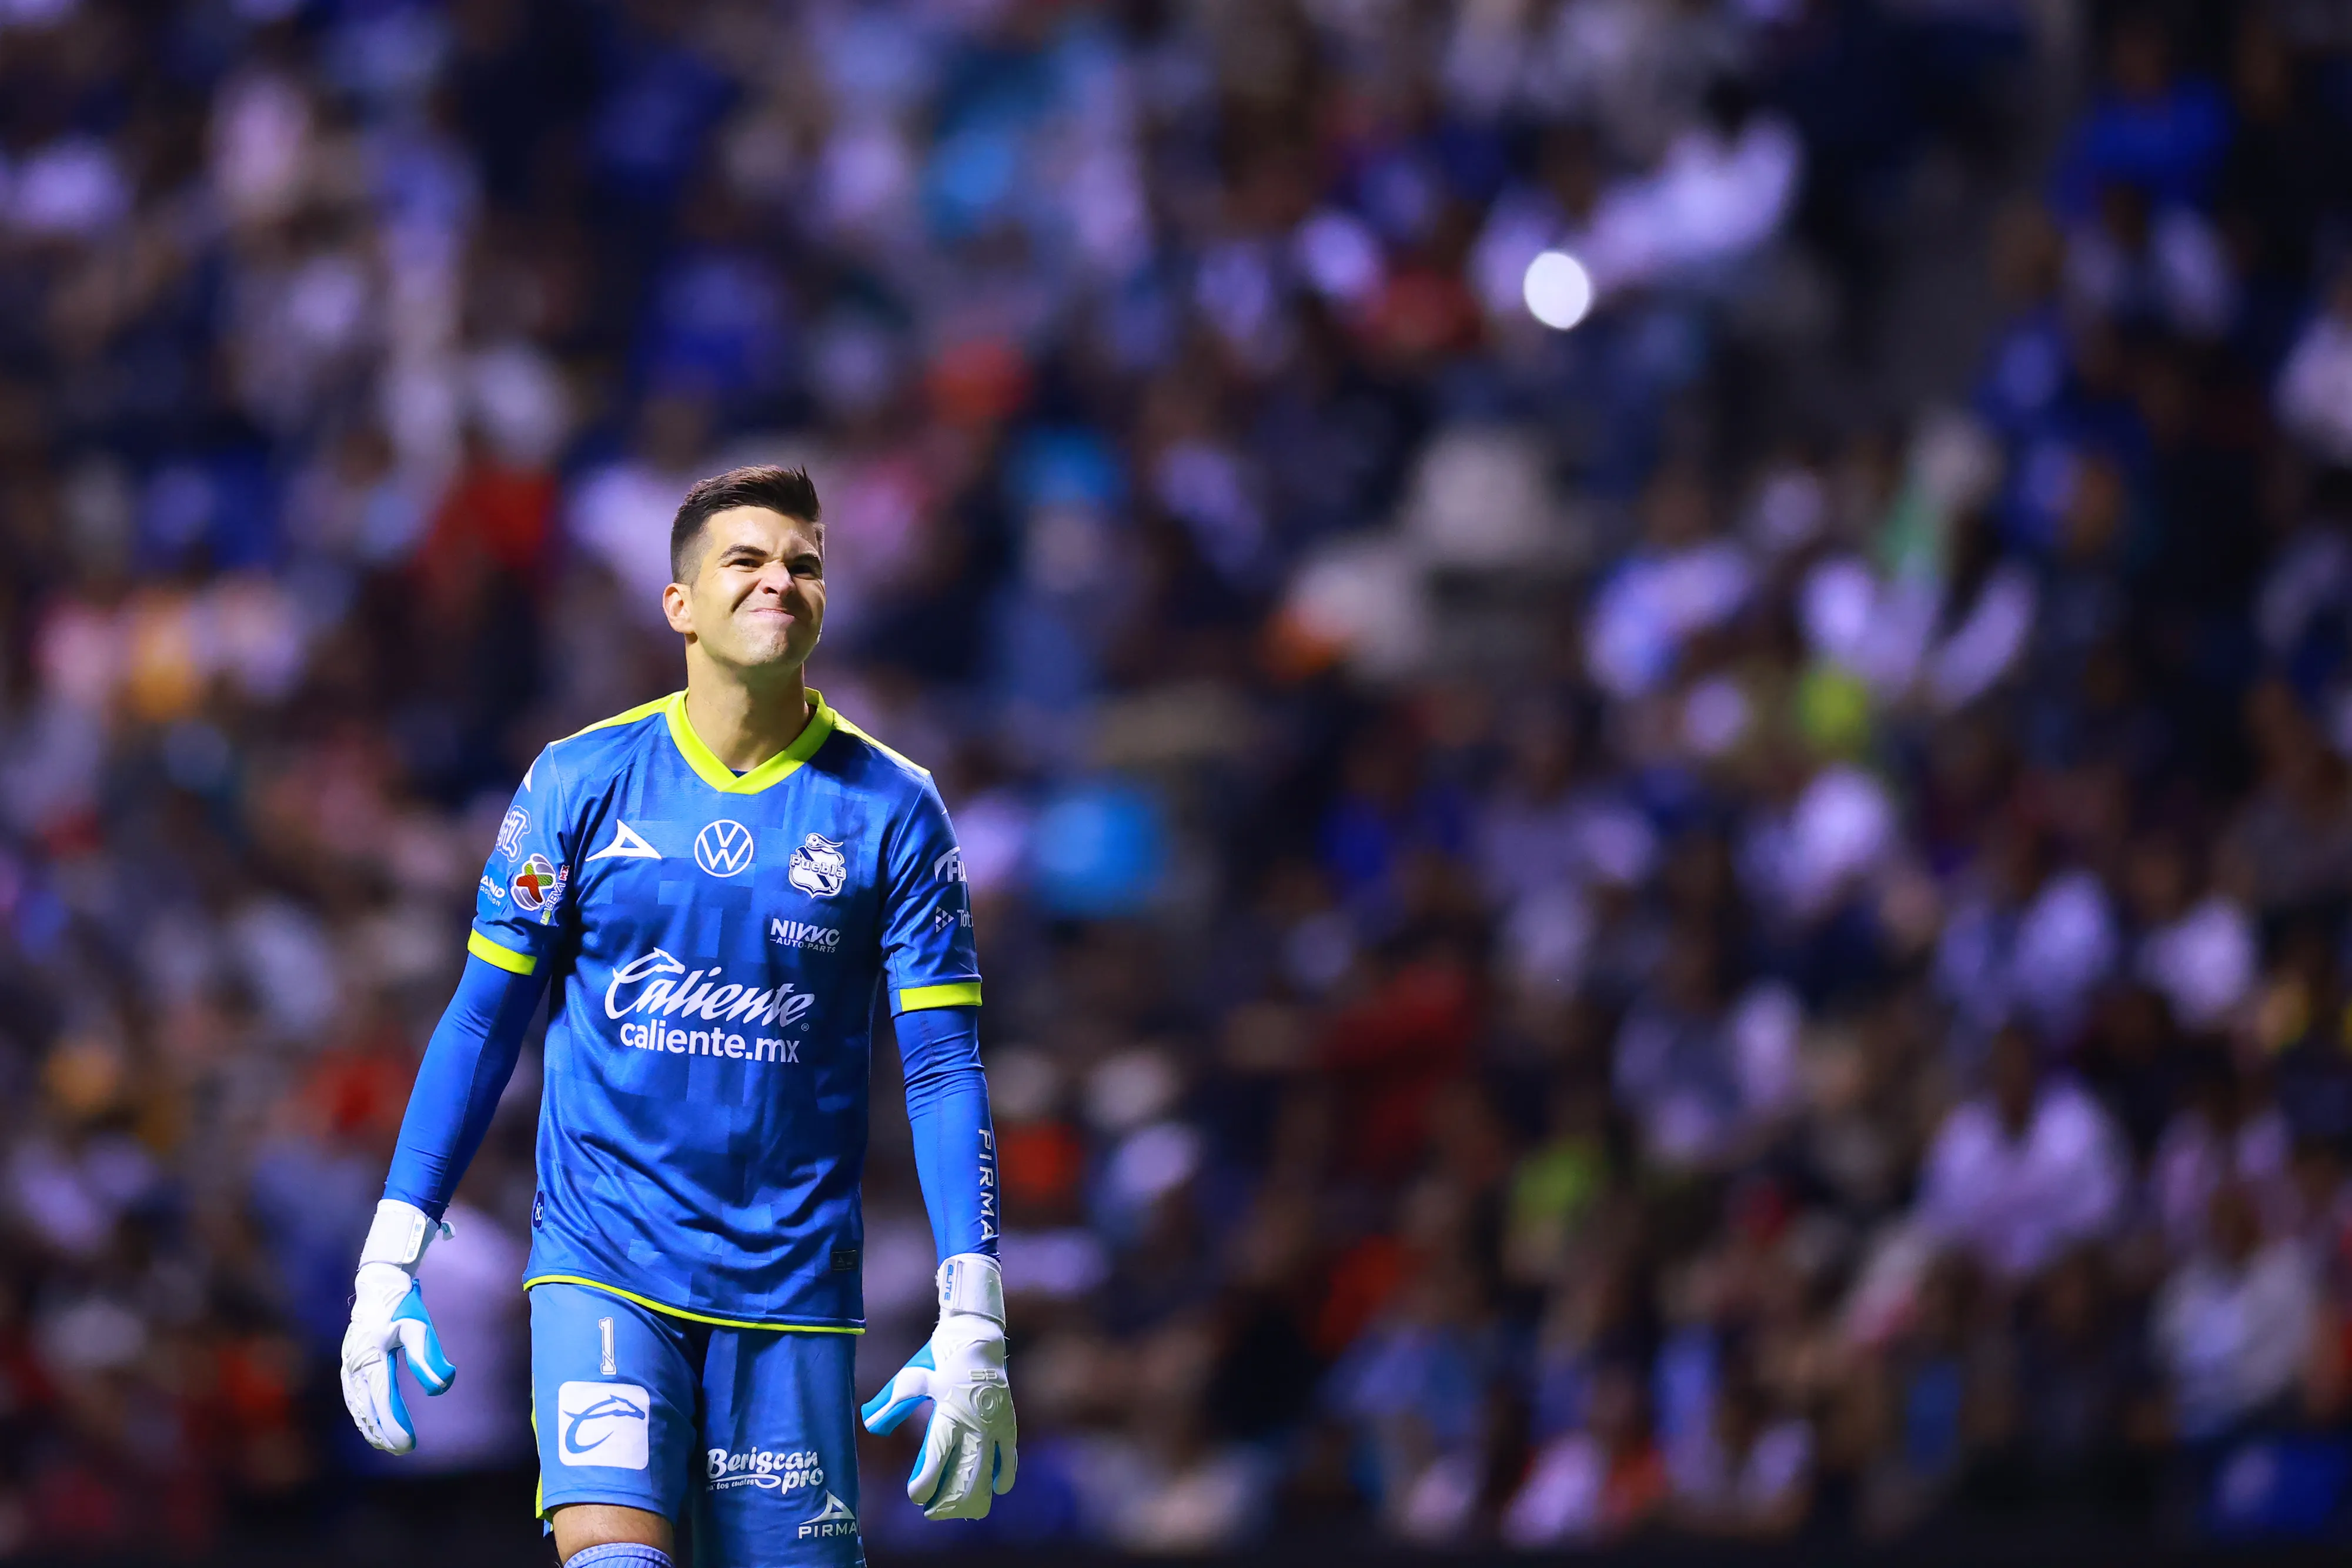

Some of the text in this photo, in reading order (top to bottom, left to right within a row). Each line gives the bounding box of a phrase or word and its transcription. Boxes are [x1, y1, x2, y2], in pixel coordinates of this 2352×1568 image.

[698, 821, 751, 873] VW
[791, 855, 846, 880] Puebla
[547, 882, 566, 912] BBVA
[559, 865, 570, 881] MX
[770, 918, 840, 947] NIKKO
[604, 947, 815, 1028] Caliente
[620, 1018, 800, 1063] caliente.mx
[978, 1128, 995, 1241] PIRMA
[943, 1263, 954, 1301] ELITE
[599, 1316, 617, 1375] 1
[706, 1446, 818, 1479] Beriscan
[781, 1467, 824, 1495] pro
[799, 1522, 858, 1539] PIRMA
